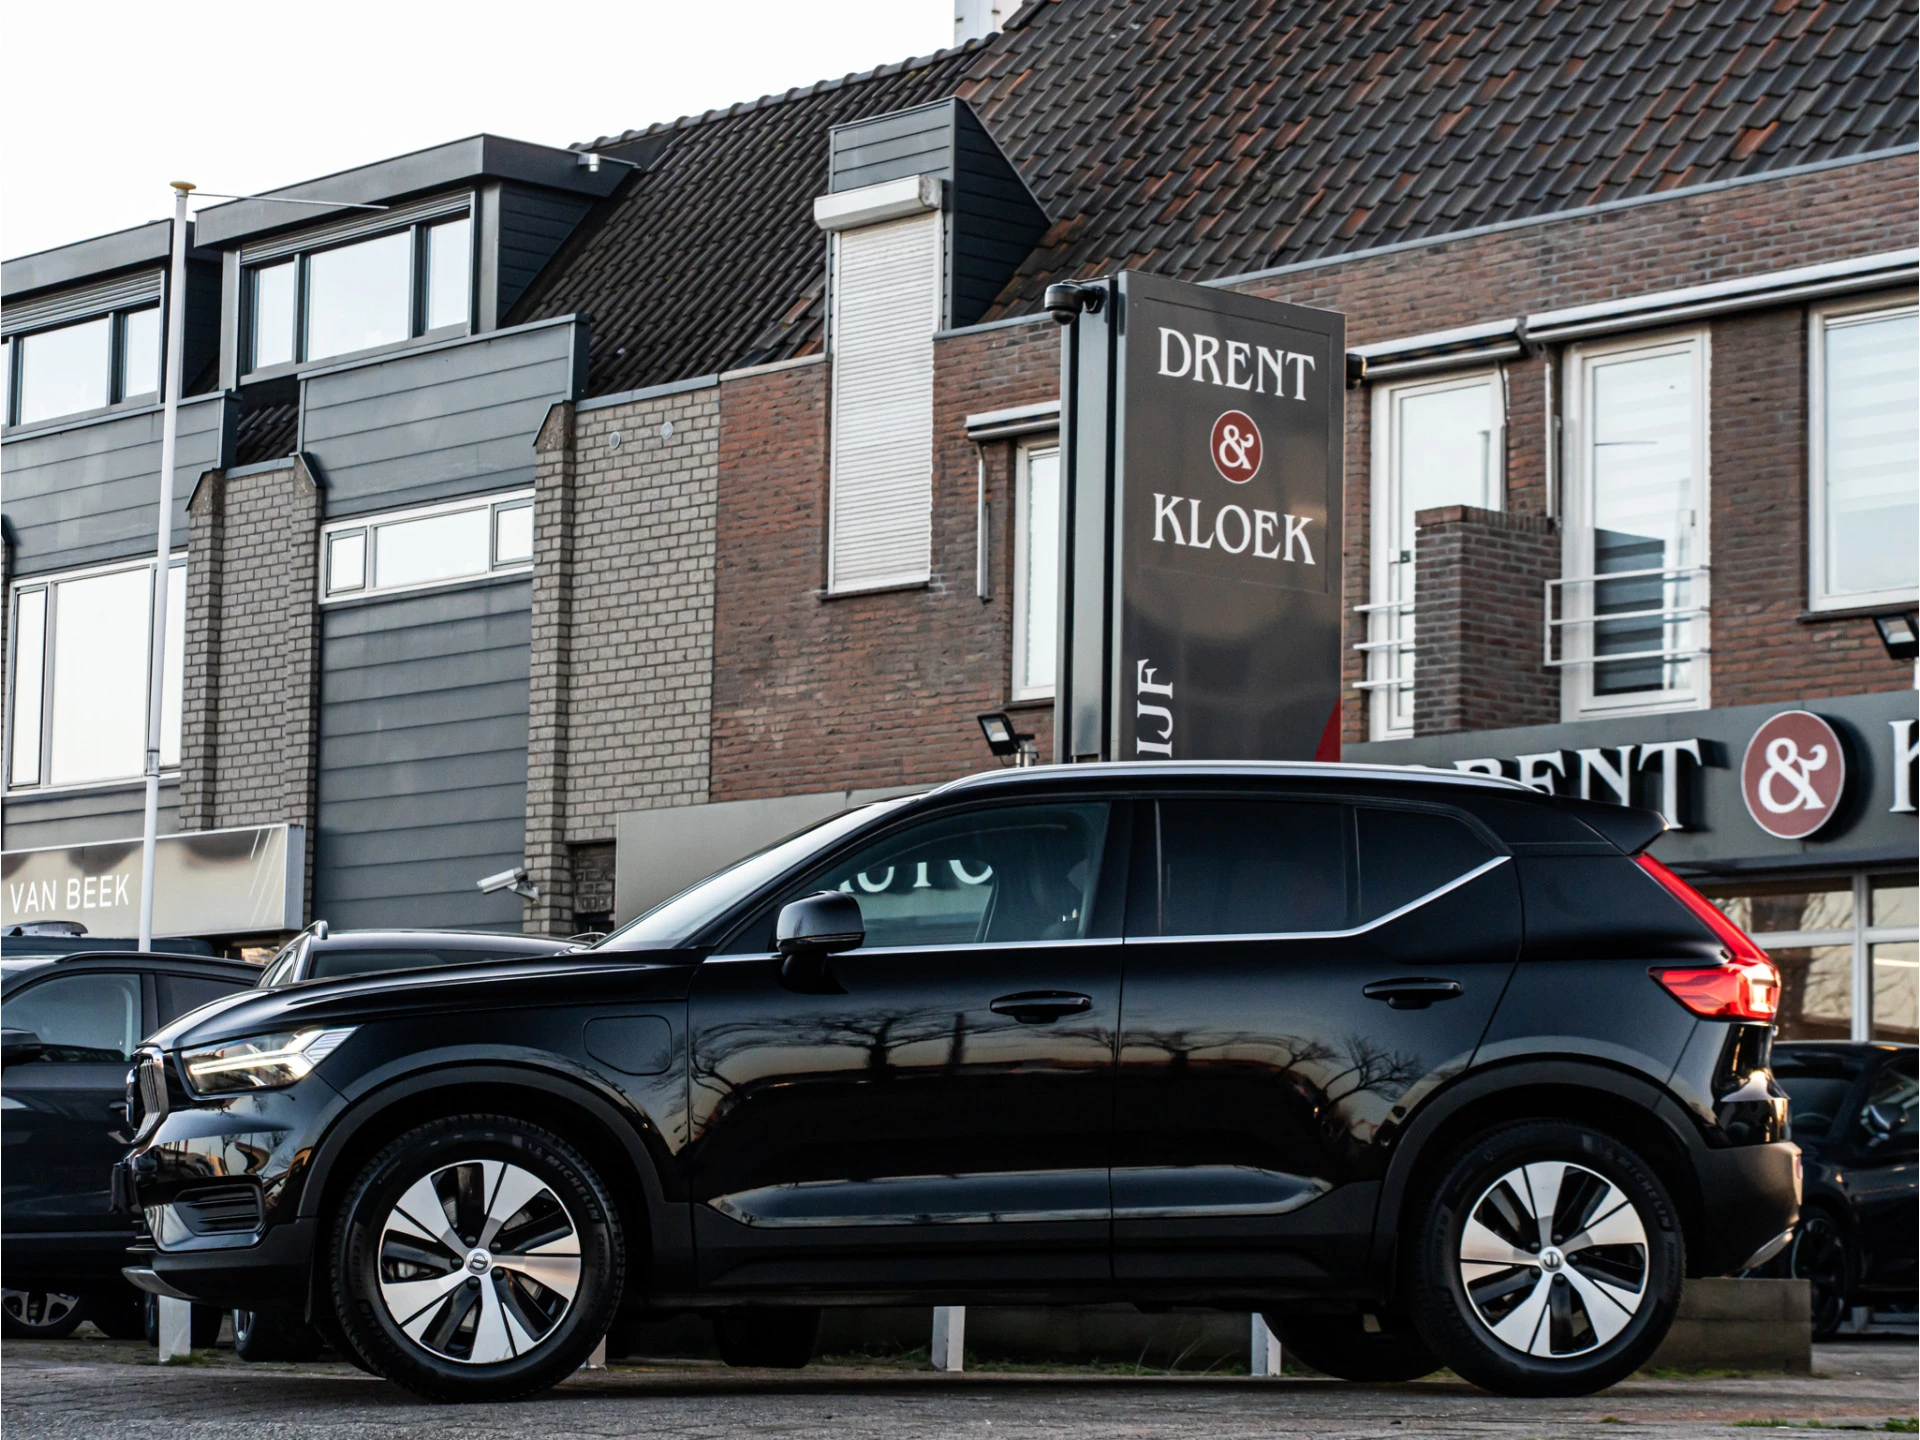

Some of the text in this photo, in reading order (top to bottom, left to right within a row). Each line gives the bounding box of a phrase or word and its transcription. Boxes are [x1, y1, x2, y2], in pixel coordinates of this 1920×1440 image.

[1157, 327, 1316, 401] DRENT
[1218, 424, 1253, 470] &
[1153, 493, 1316, 565] KLOEK
[1758, 736, 1828, 814] &
[10, 873, 130, 915] VAN BEEK
